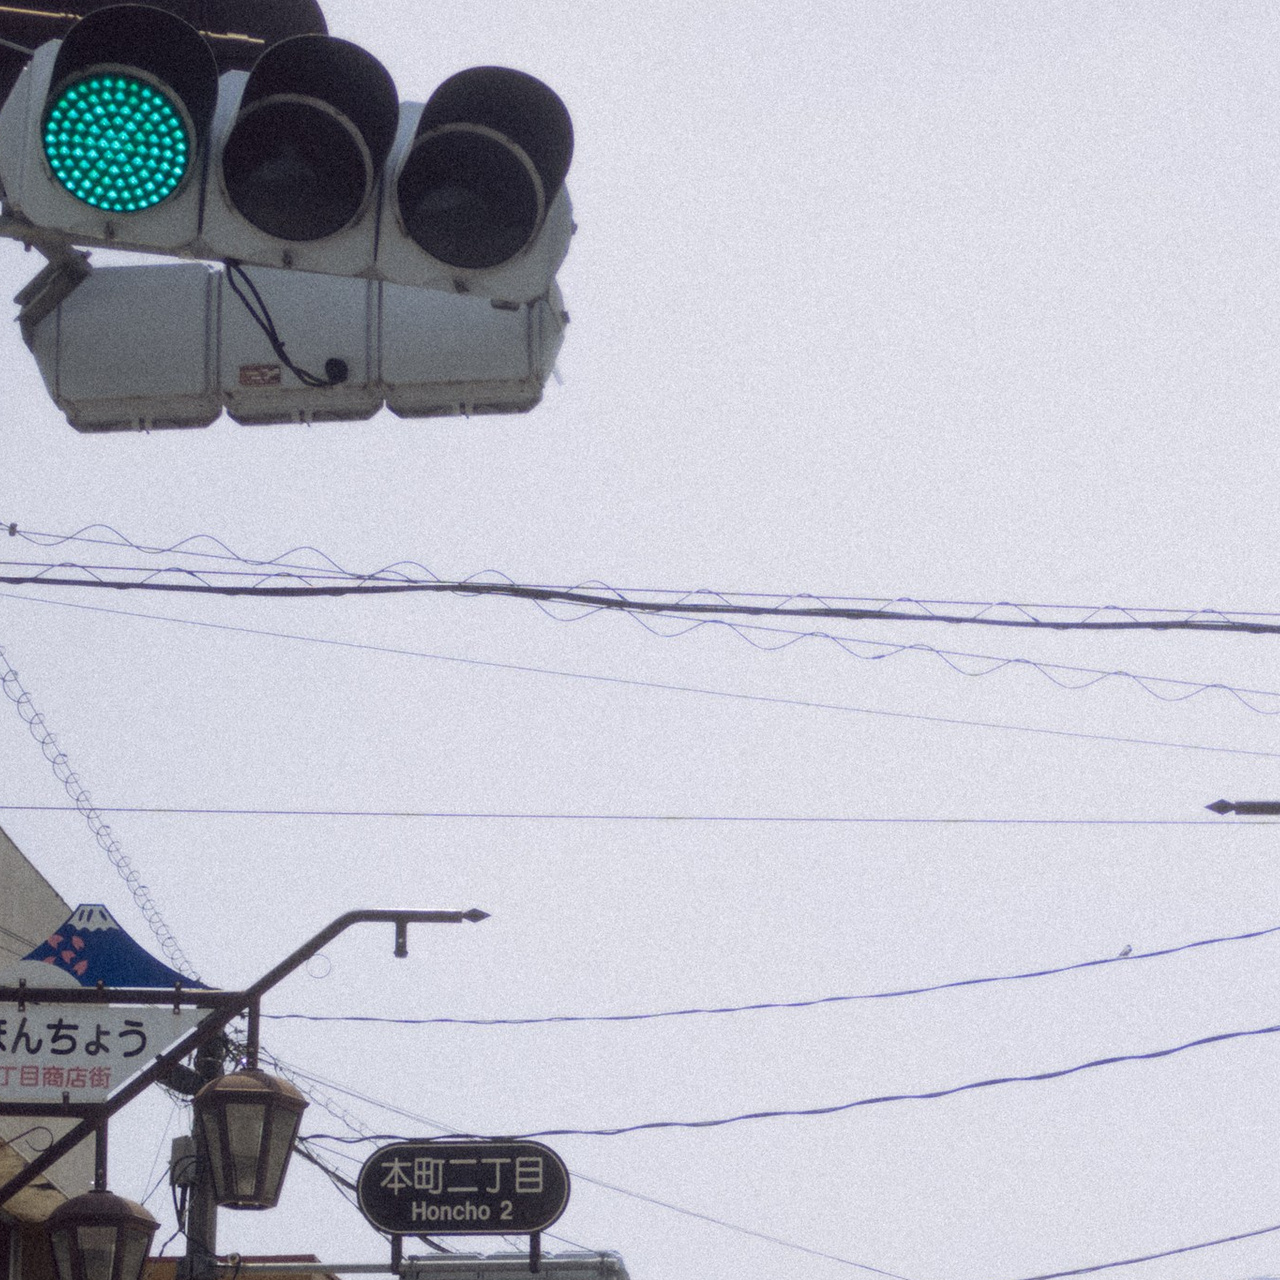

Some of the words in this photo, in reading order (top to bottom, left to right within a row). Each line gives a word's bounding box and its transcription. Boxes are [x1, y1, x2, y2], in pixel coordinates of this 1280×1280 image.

[380, 1156, 543, 1195] 本町二丁目
[412, 1201, 491, 1221] Honcho
[500, 1201, 513, 1220] 2
